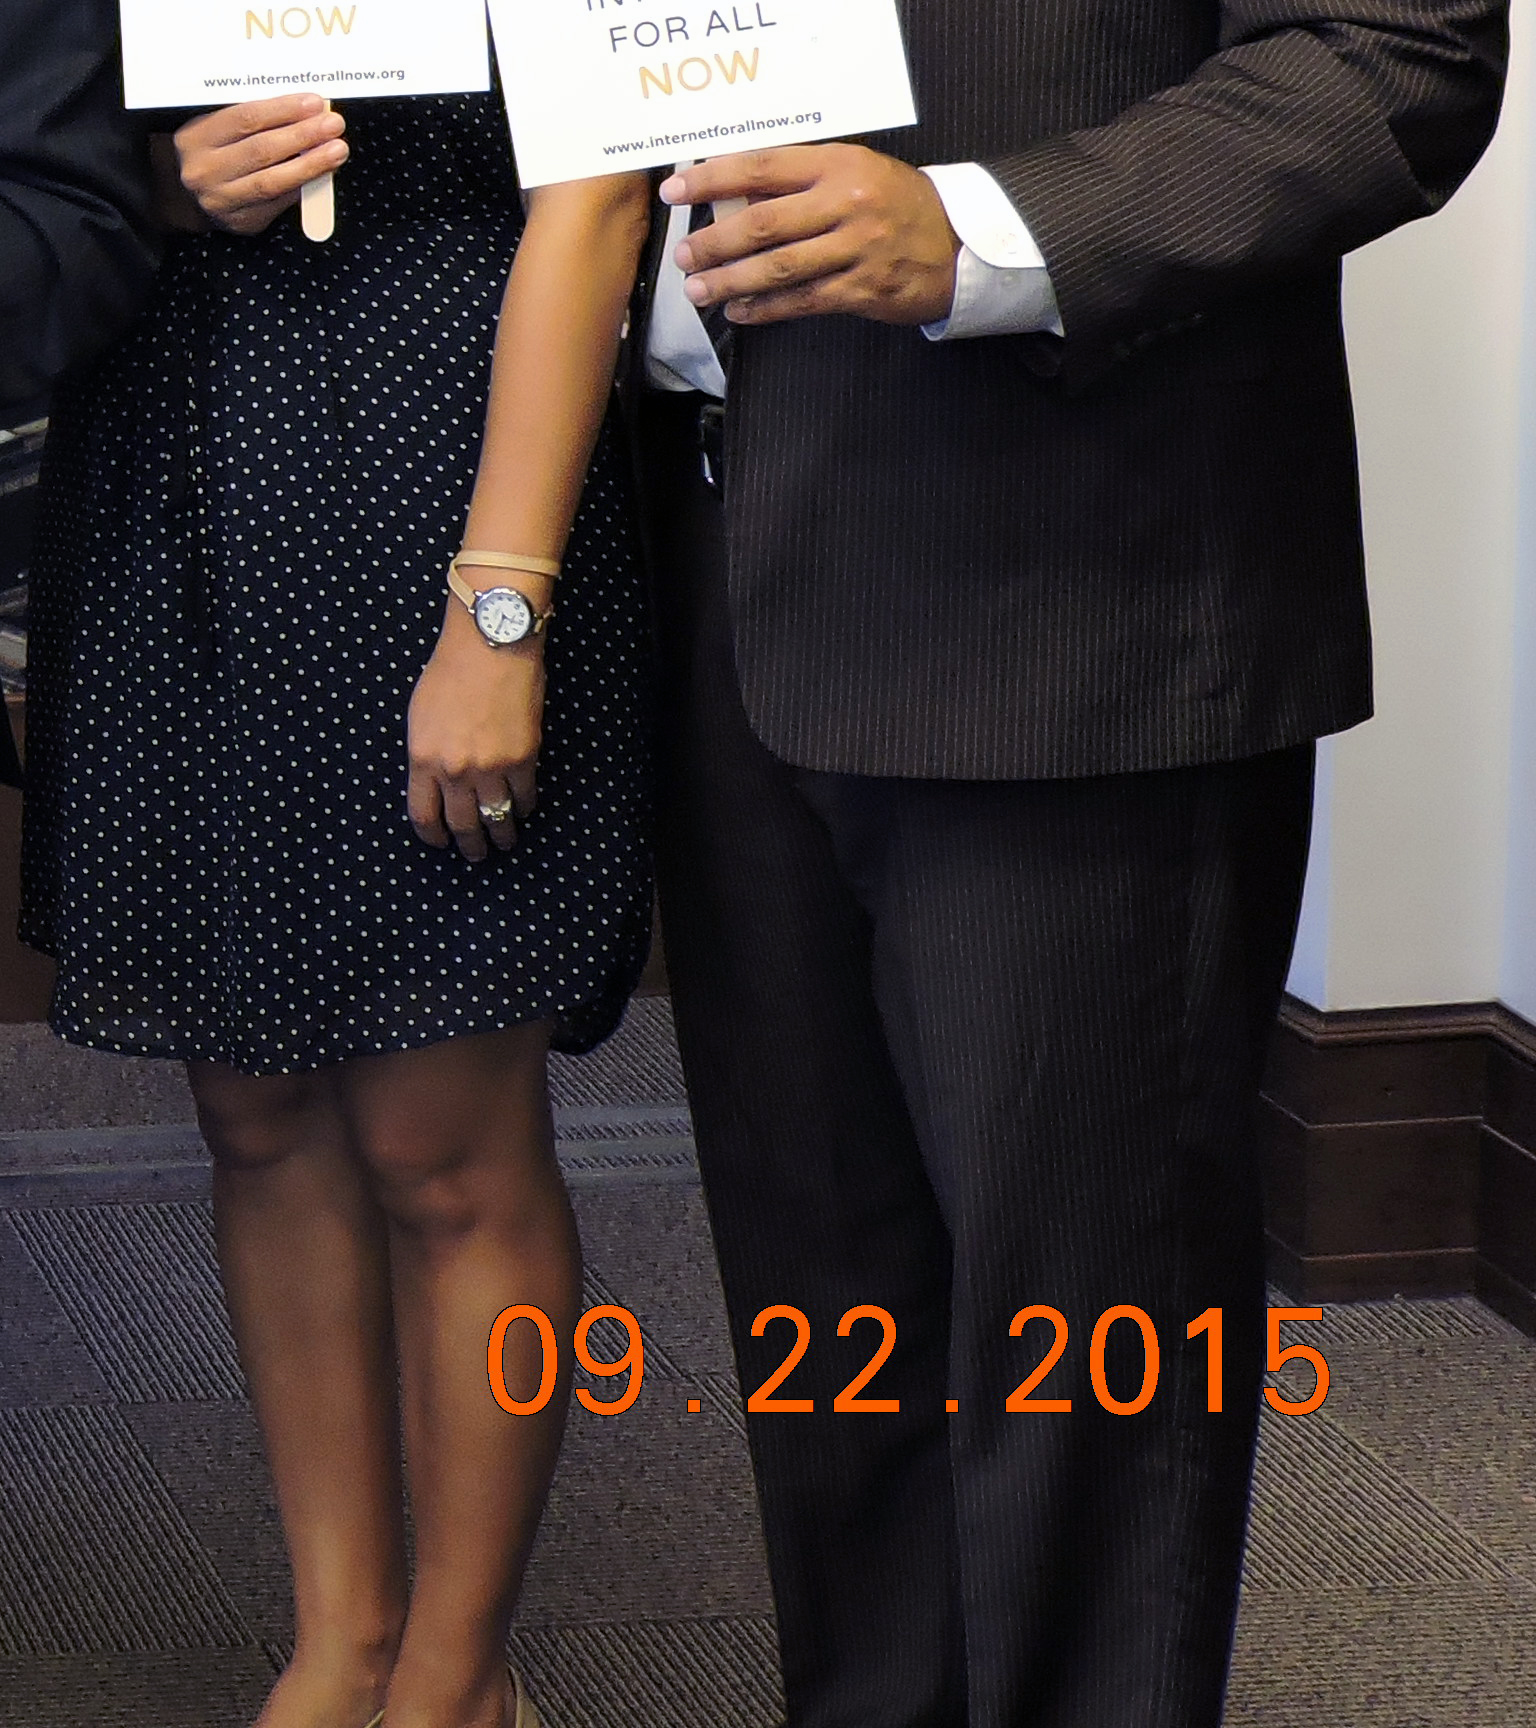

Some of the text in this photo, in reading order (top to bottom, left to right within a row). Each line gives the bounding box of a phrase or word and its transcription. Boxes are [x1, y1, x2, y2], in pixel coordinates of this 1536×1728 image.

[245, 4, 357, 40] NOW
[609, 1, 777, 53] FOR ALL
[203, 69, 405, 88] www.internetforallnow.org
[638, 47, 759, 99] NOW
[602, 111, 822, 155] www.internetforallnow.org
